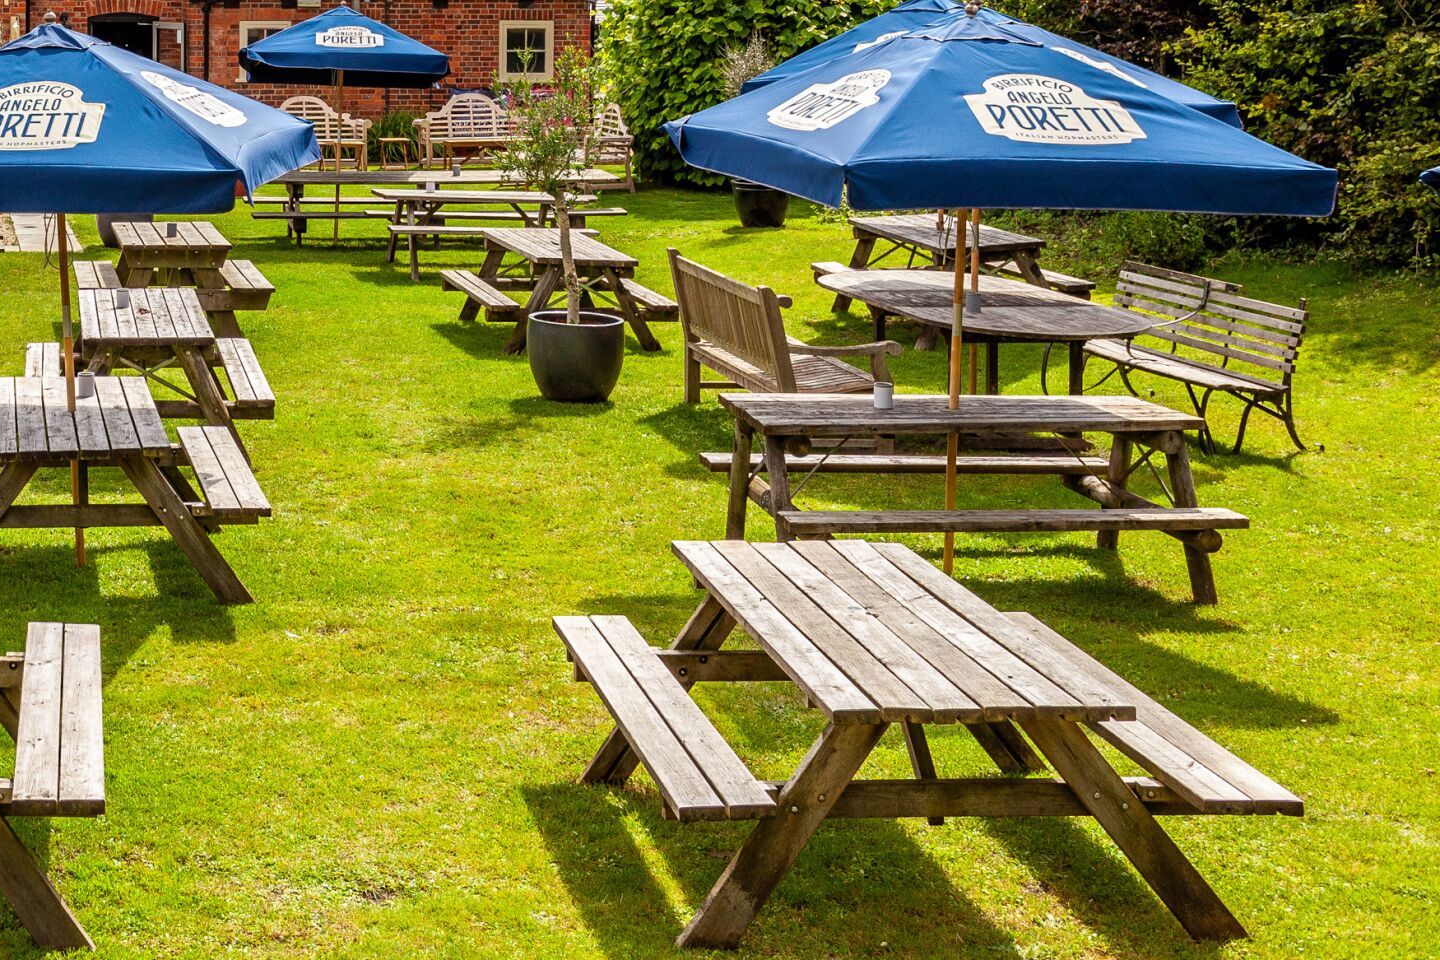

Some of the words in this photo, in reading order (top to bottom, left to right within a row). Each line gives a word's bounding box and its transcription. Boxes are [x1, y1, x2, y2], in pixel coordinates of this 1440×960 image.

[323, 35, 376, 44] PORETTI
[991, 78, 1073, 93] BIRRIFICIO
[0, 98, 62, 112] ANGELO
[1007, 91, 1072, 105] ANGELO
[780, 92, 860, 124] PORETTI
[985, 104, 1126, 132] PORETTI
